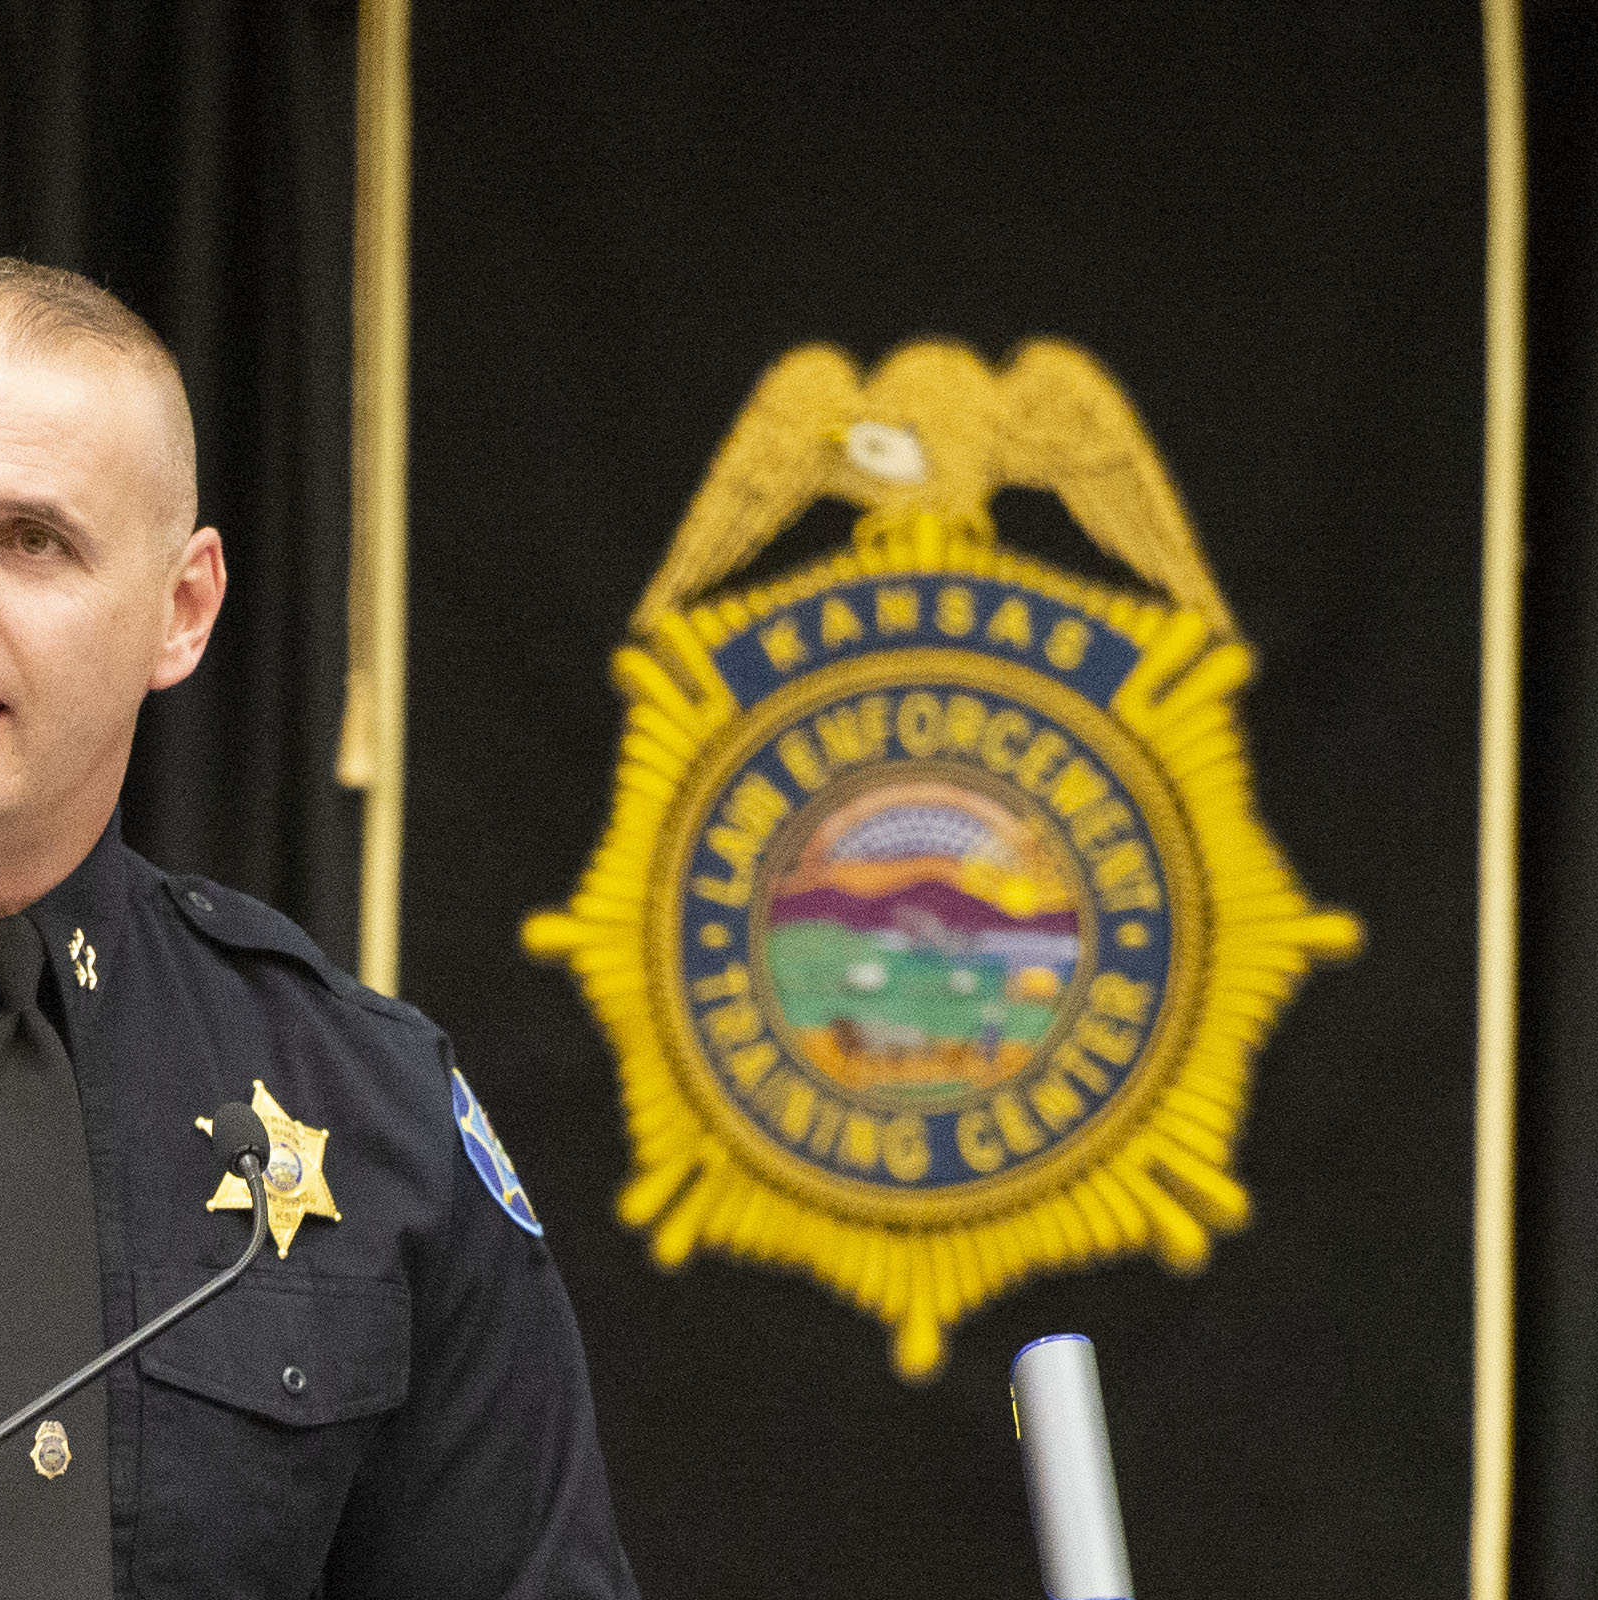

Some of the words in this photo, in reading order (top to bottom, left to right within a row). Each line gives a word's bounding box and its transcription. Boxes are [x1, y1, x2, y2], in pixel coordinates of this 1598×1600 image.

[759, 585, 1092, 671] KANSAS
[693, 773, 789, 908] LAW
[778, 691, 1161, 913] ENFORCEMENT
[693, 962, 930, 1181] TRAINING
[957, 972, 1153, 1172] CENTER
